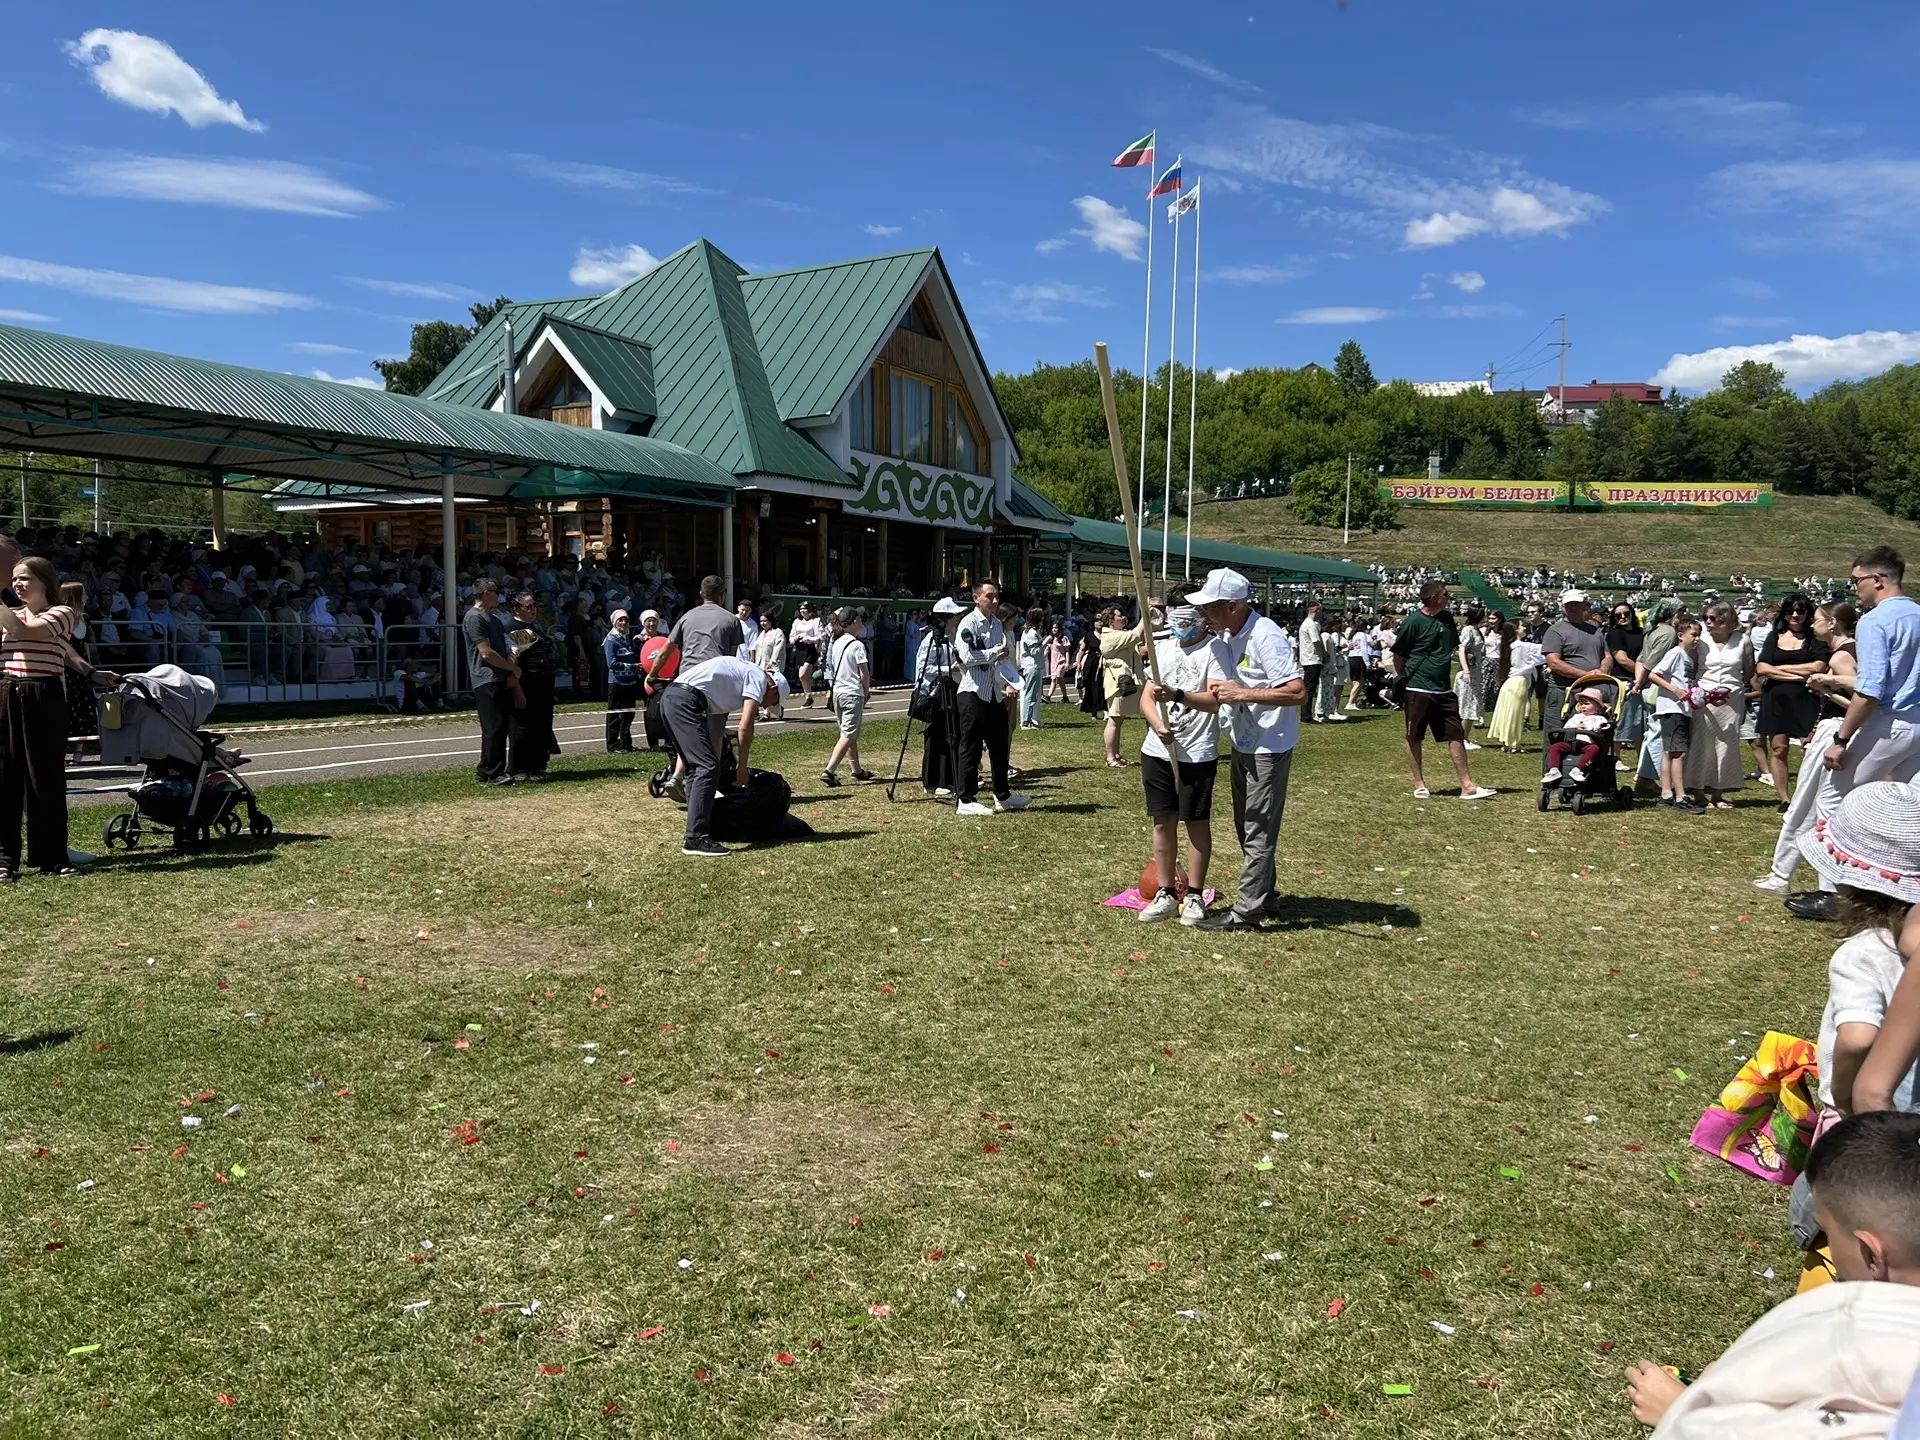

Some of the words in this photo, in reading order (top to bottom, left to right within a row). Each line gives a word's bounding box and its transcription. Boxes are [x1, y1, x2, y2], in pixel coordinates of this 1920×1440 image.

[1391, 482, 1476, 500] БӘЙРӘМ
[1482, 487, 1555, 501] БЕЛӘН!
[1607, 488, 1758, 504] ПРАЗДНИКОМ!
